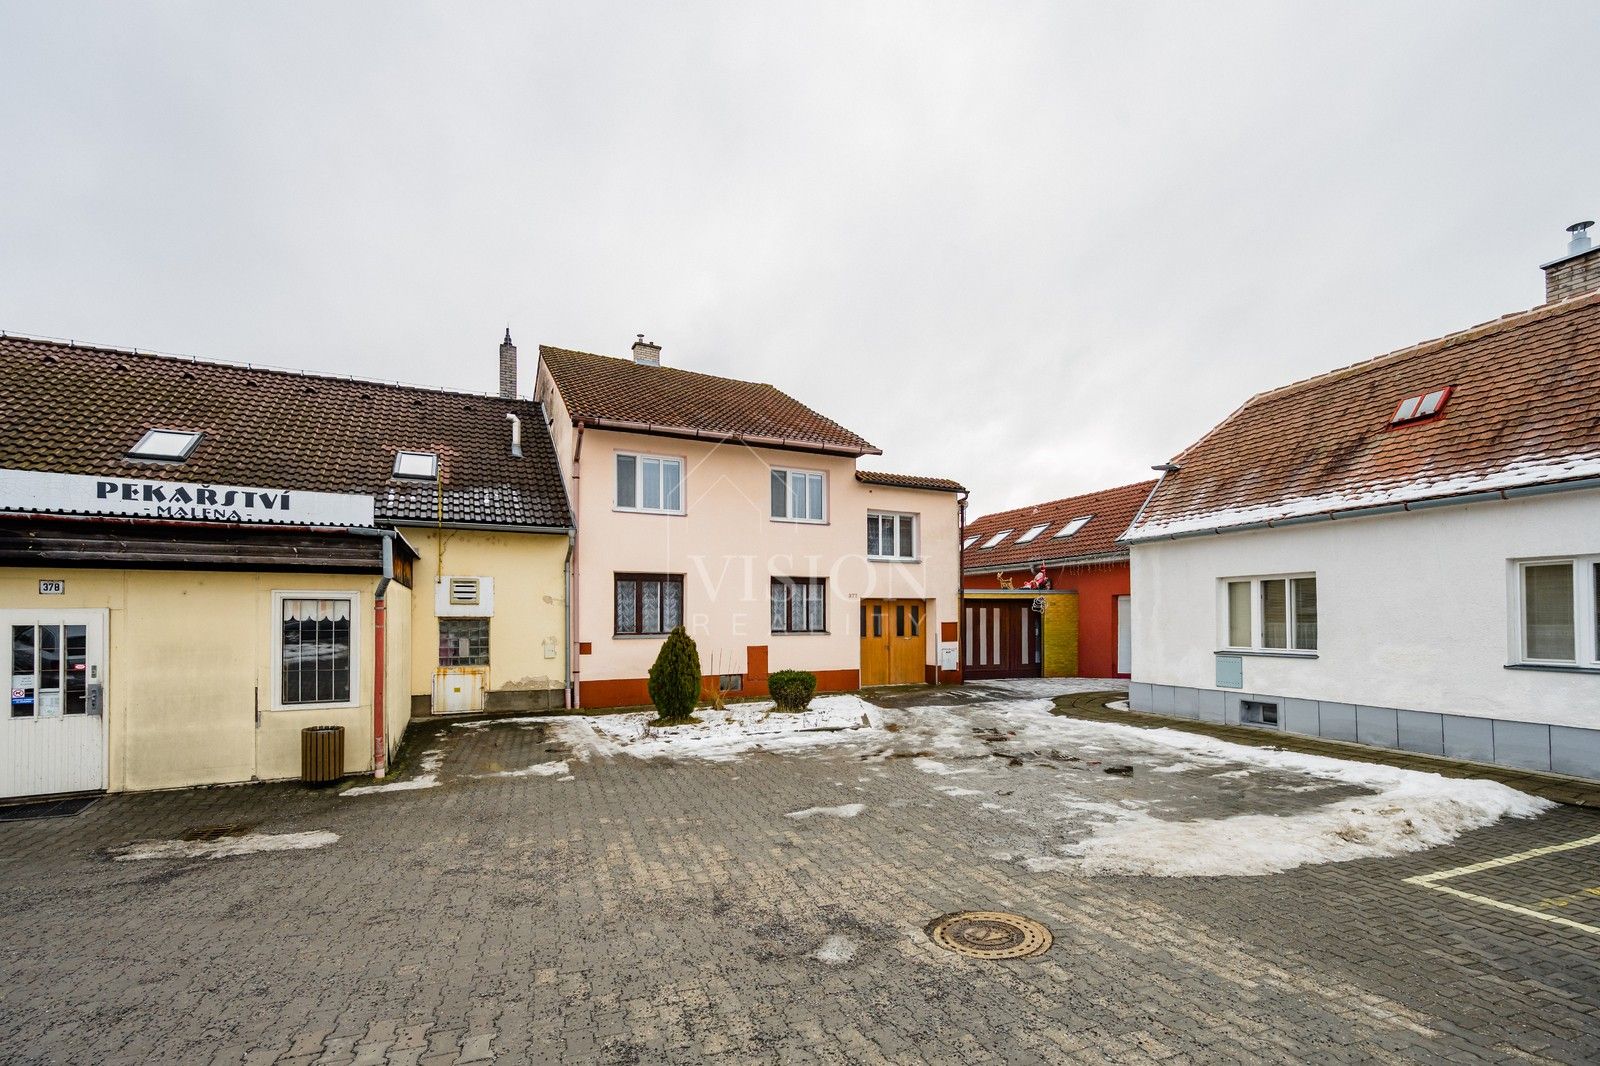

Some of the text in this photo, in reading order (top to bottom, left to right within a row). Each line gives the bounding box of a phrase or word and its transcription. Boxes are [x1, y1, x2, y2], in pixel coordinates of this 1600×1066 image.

[97, 481, 290, 511] PEKAŘSTVÍ
[157, 505, 242, 520] MALENA
[42, 582, 60, 592] 378
